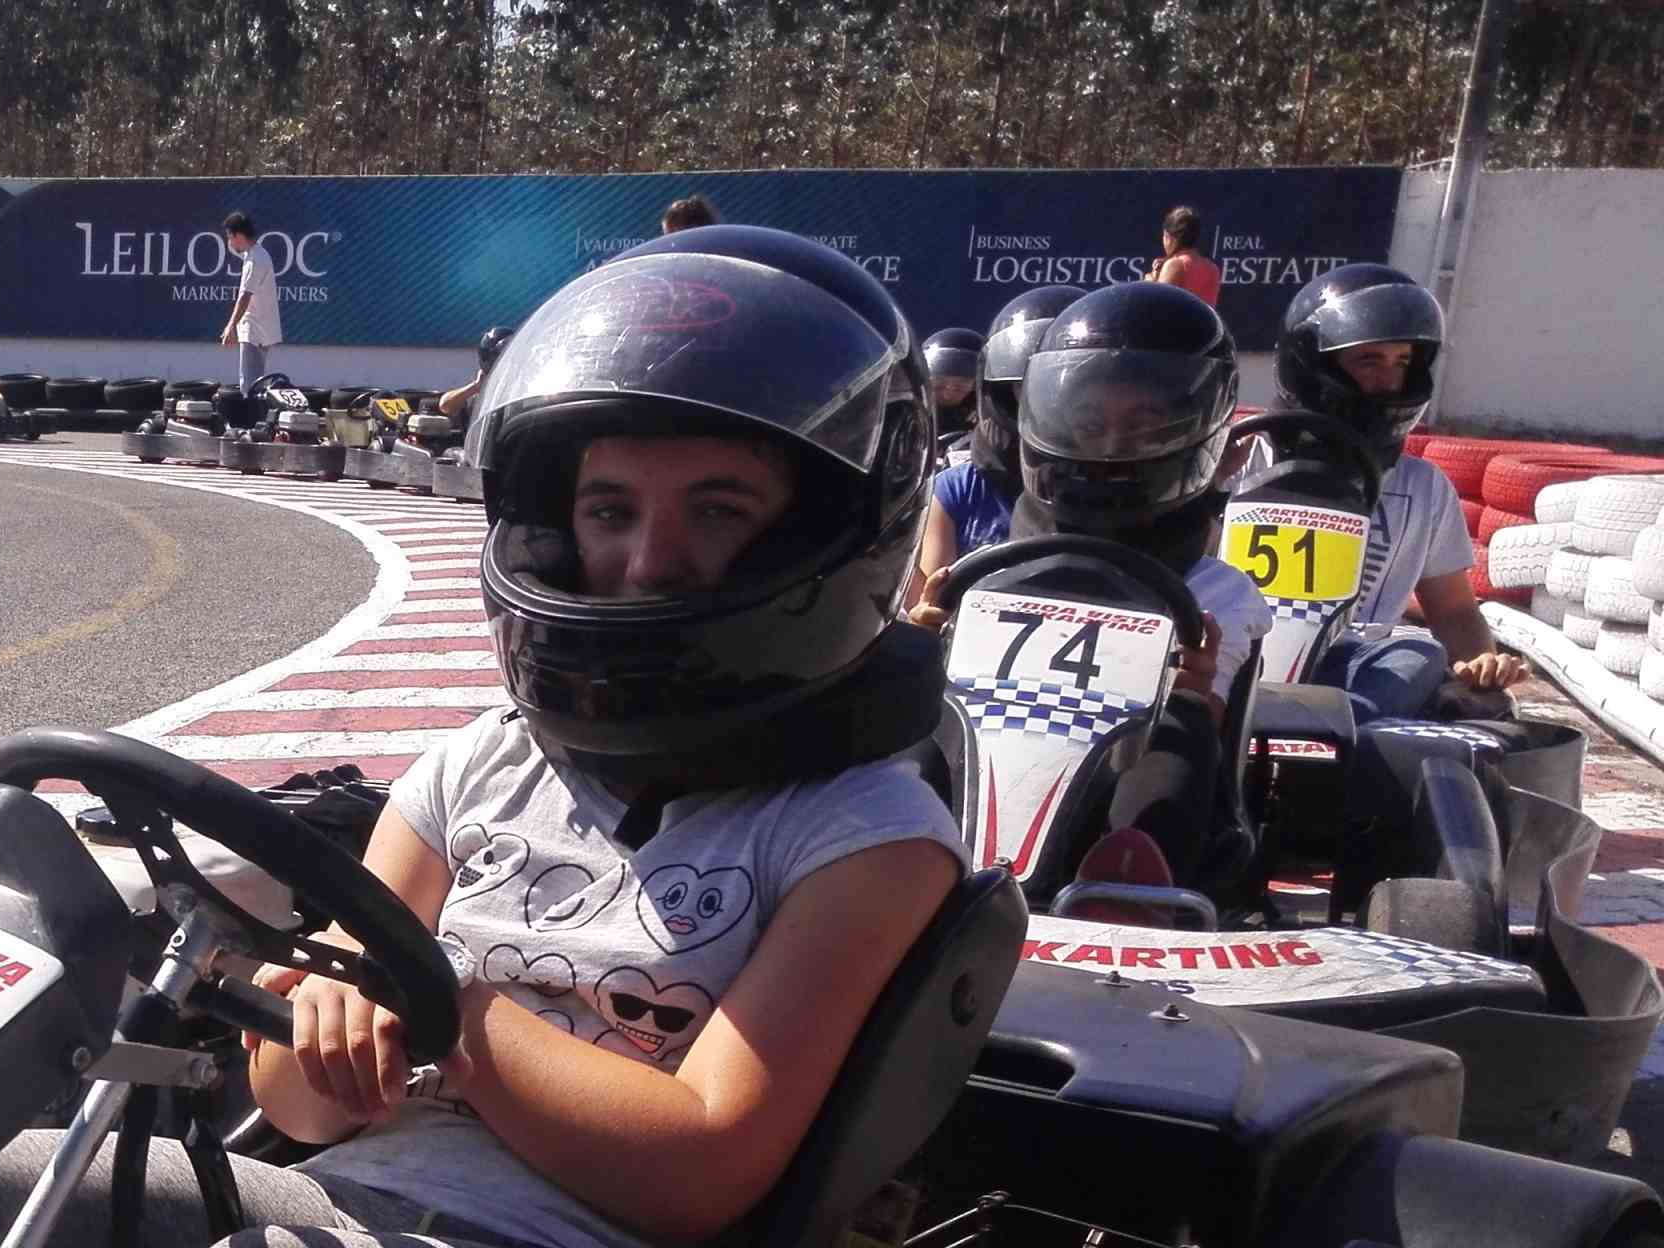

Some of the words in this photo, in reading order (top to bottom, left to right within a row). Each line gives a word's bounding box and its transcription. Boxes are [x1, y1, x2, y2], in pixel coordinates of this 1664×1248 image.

[977, 235, 1050, 249] BUSINESS
[1223, 235, 1264, 250] REAL
[974, 256, 1144, 284] LOGISTICS
[1298, 519, 1364, 536] BATALHA
[1246, 525, 1315, 593] 51
[1022, 602, 1077, 615] BOA
[1087, 610, 1162, 626] VISTA
[995, 610, 1101, 690] 74
[1023, 939, 1324, 970] KARTING
